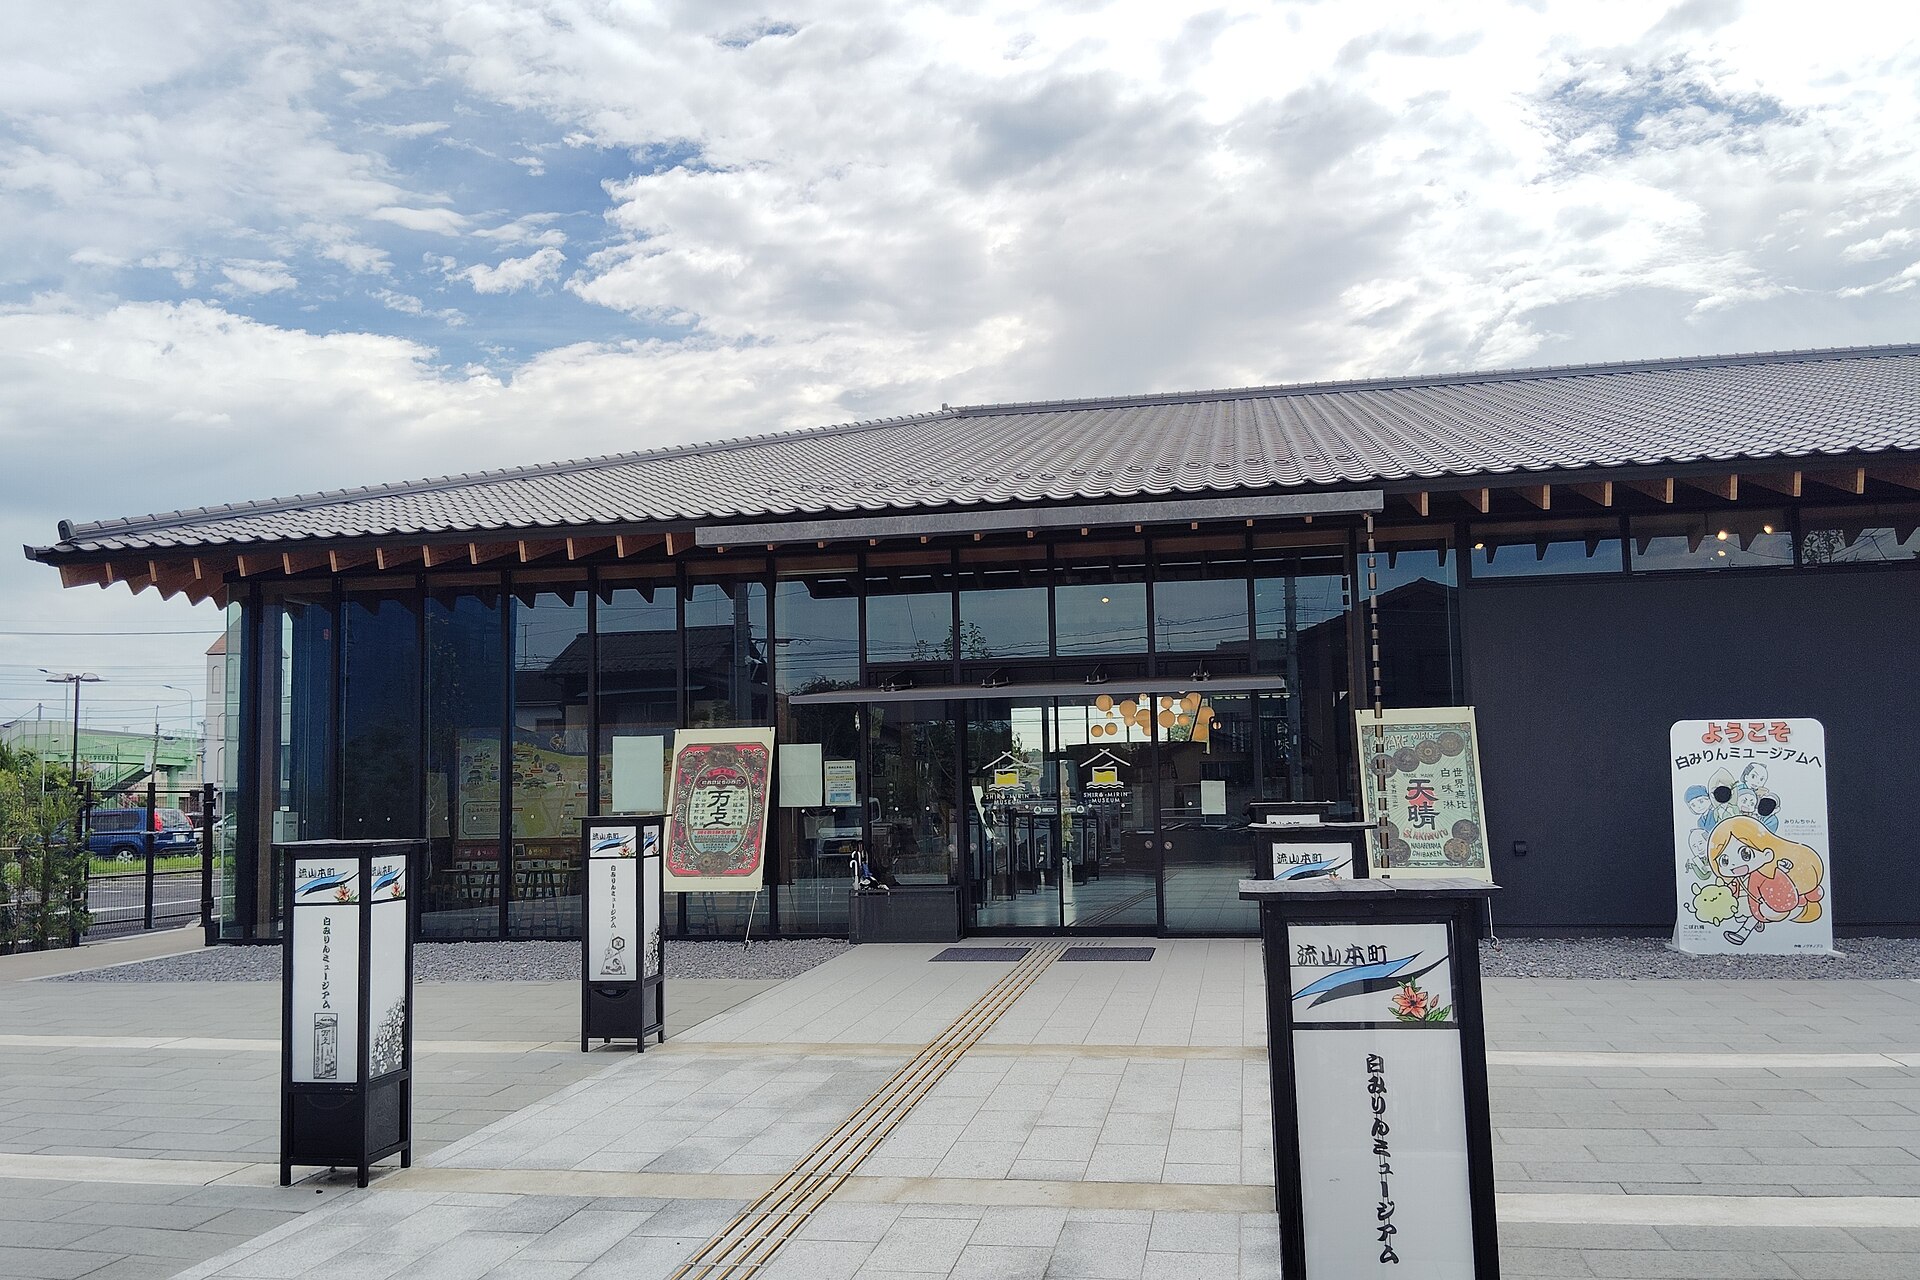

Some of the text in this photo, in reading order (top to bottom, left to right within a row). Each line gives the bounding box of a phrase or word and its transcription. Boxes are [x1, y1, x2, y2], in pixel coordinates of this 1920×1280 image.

[1701, 721, 1791, 744] ようこそ
[1675, 746, 1823, 770] 白みりんミュージアムへ
[1440, 768, 1455, 809] 白味淋
[1404, 779, 1440, 830] 天晴
[1276, 852, 1322, 864] 流山本町
[1411, 850, 1443, 858] CHIBAKEN
[298, 867, 335, 878] 流山本町
[321, 916, 331, 1009] 白みりんミュージアム
[1296, 944, 1388, 966] 流山本町
[1364, 1053, 1400, 1265] 白みりんミュージアム
